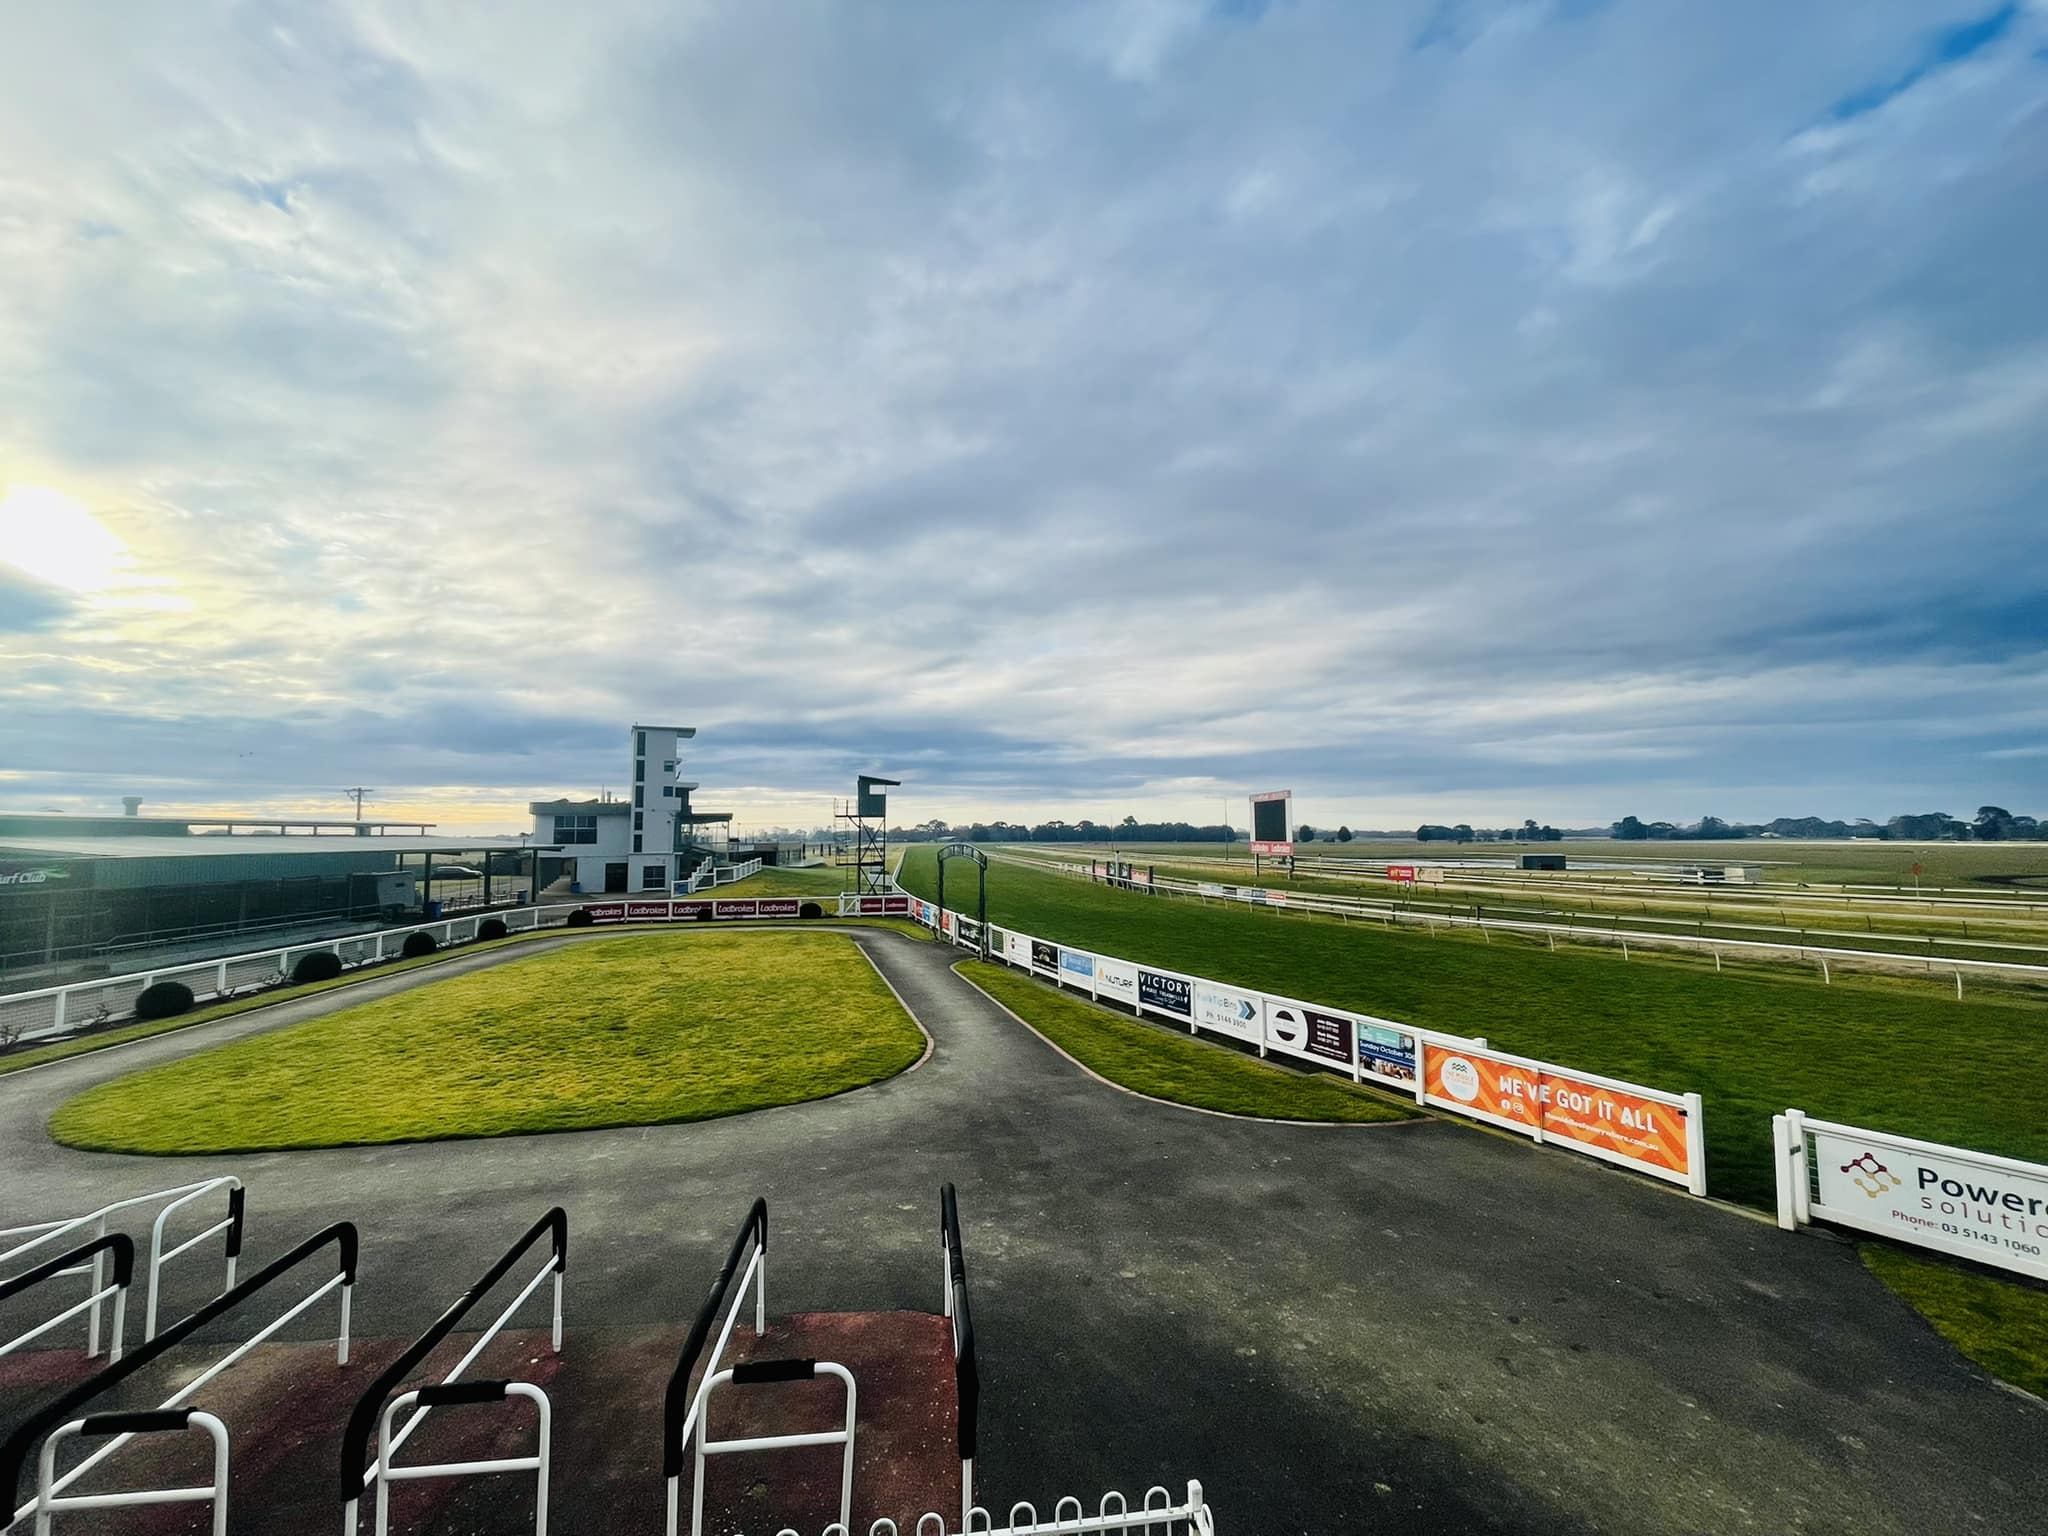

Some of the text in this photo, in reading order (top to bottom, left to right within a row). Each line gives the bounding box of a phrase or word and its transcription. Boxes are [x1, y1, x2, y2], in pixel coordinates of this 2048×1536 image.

[0, 871, 47, 885] urf Club
[590, 907, 622, 916] adbrokes
[629, 906, 667, 915] Ladbrokes
[674, 904, 712, 914] Ladbro
[718, 904, 754, 913] Ladbrokes
[760, 903, 796, 912] Ladbrokes
[1140, 972, 1190, 995] VICTORY
[1380, 1045, 1404, 1058] October
[1499, 1075, 1551, 1104] WE'VE
[1556, 1090, 1592, 1115] GOT
[1597, 1099, 1613, 1121] IT
[1620, 1106, 1658, 1134] ALL
[1917, 1167, 2048, 1216] Power
[1892, 1209, 2041, 1256] Phone: 03 5143 1060
